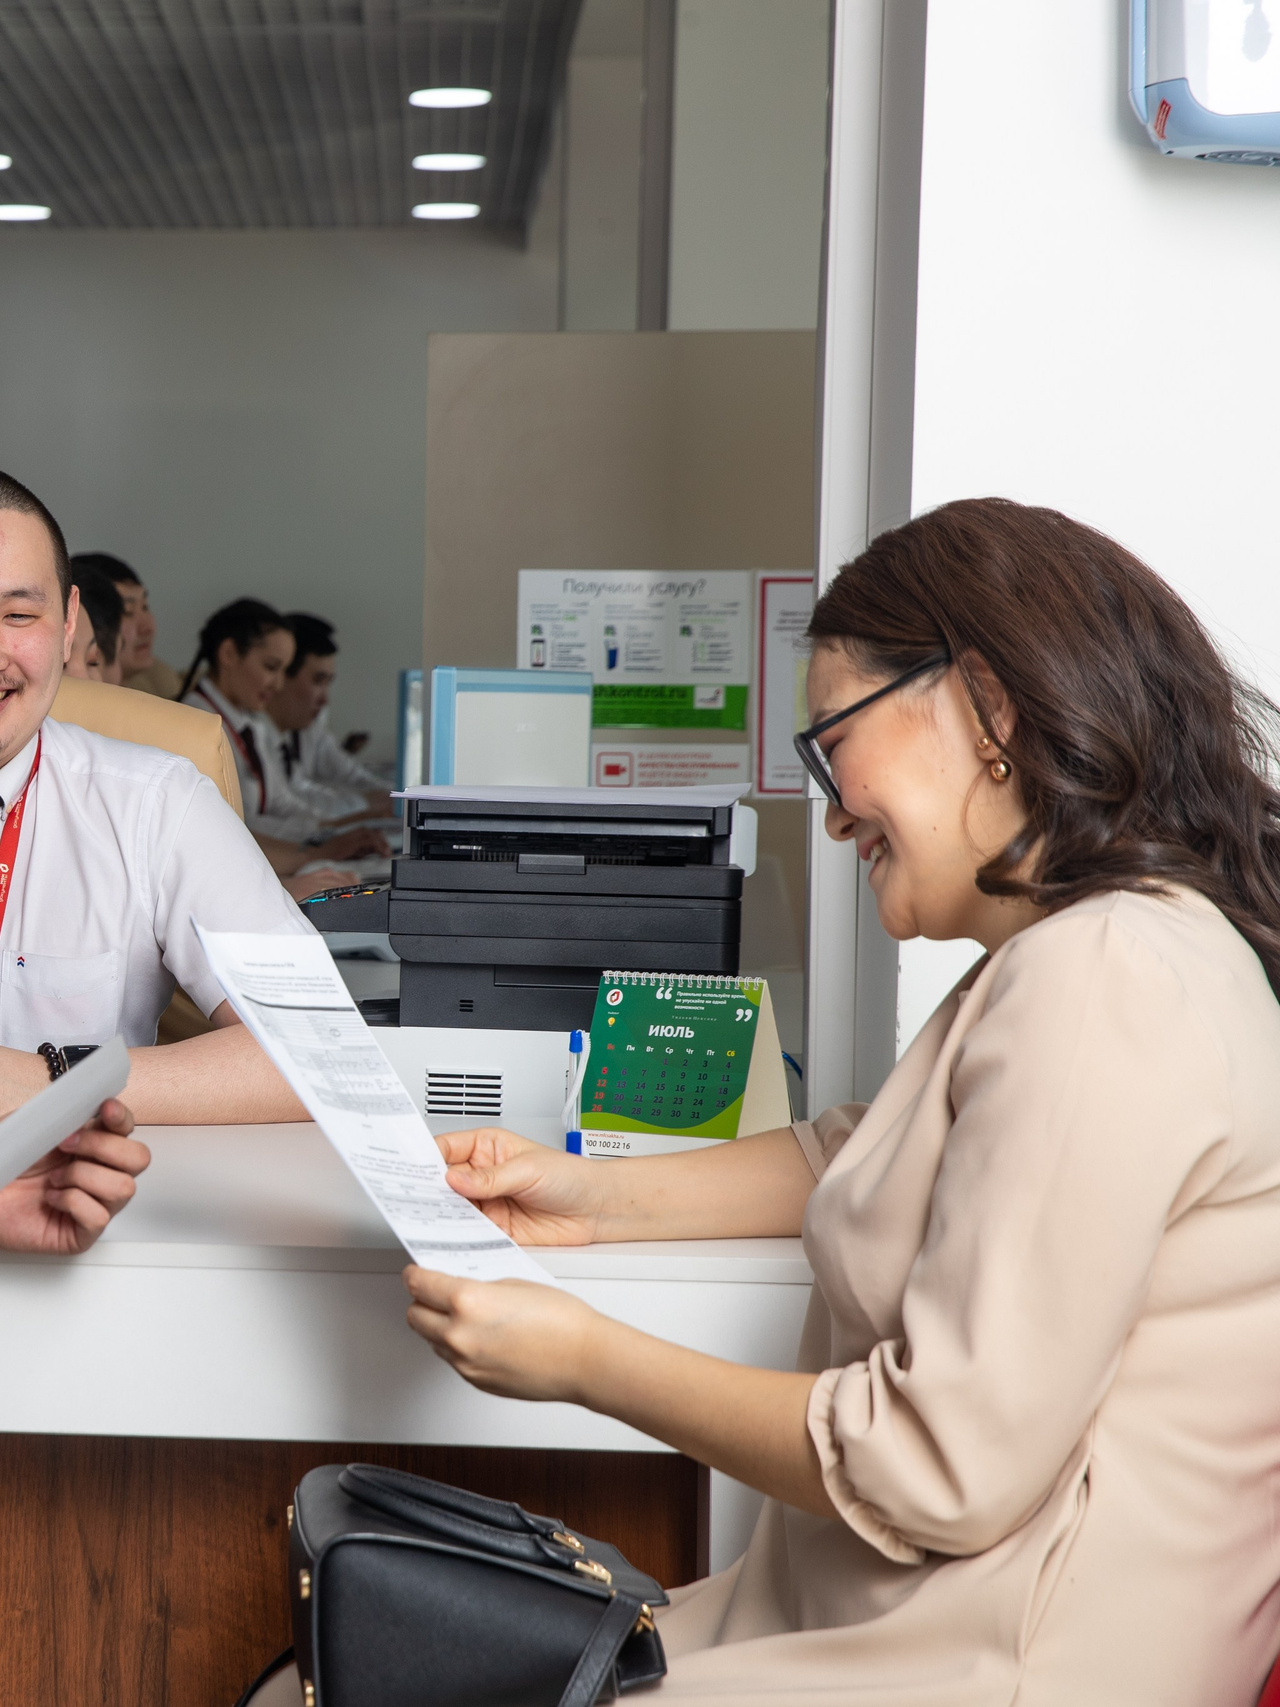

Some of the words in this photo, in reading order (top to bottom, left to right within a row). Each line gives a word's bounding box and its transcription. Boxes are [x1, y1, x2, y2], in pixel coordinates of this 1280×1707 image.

[562, 578, 644, 597] Получили
[647, 578, 708, 599] услугу?
[593, 684, 687, 698] shkontrol.ru
[648, 1024, 695, 1039] ИЮЛЬ
[665, 1047, 674, 1055] Ср
[697, 1073, 708, 1081] 10
[597, 1079, 607, 1087] 12
[617, 1081, 626, 1089] 13
[656, 1083, 666, 1091] 15
[675, 1084, 685, 1092] 16
[718, 1087, 728, 1095] 18
[614, 1093, 624, 1101] 20
[653, 1096, 663, 1104] 22
[673, 1097, 683, 1105] 23
[693, 1098, 704, 1106] 24
[715, 1100, 726, 1108] 25
[592, 1104, 602, 1112] 26
[631, 1107, 642, 1115] 28
[691, 1111, 700, 1119] 31
[612, 1141, 621, 1149] 22
